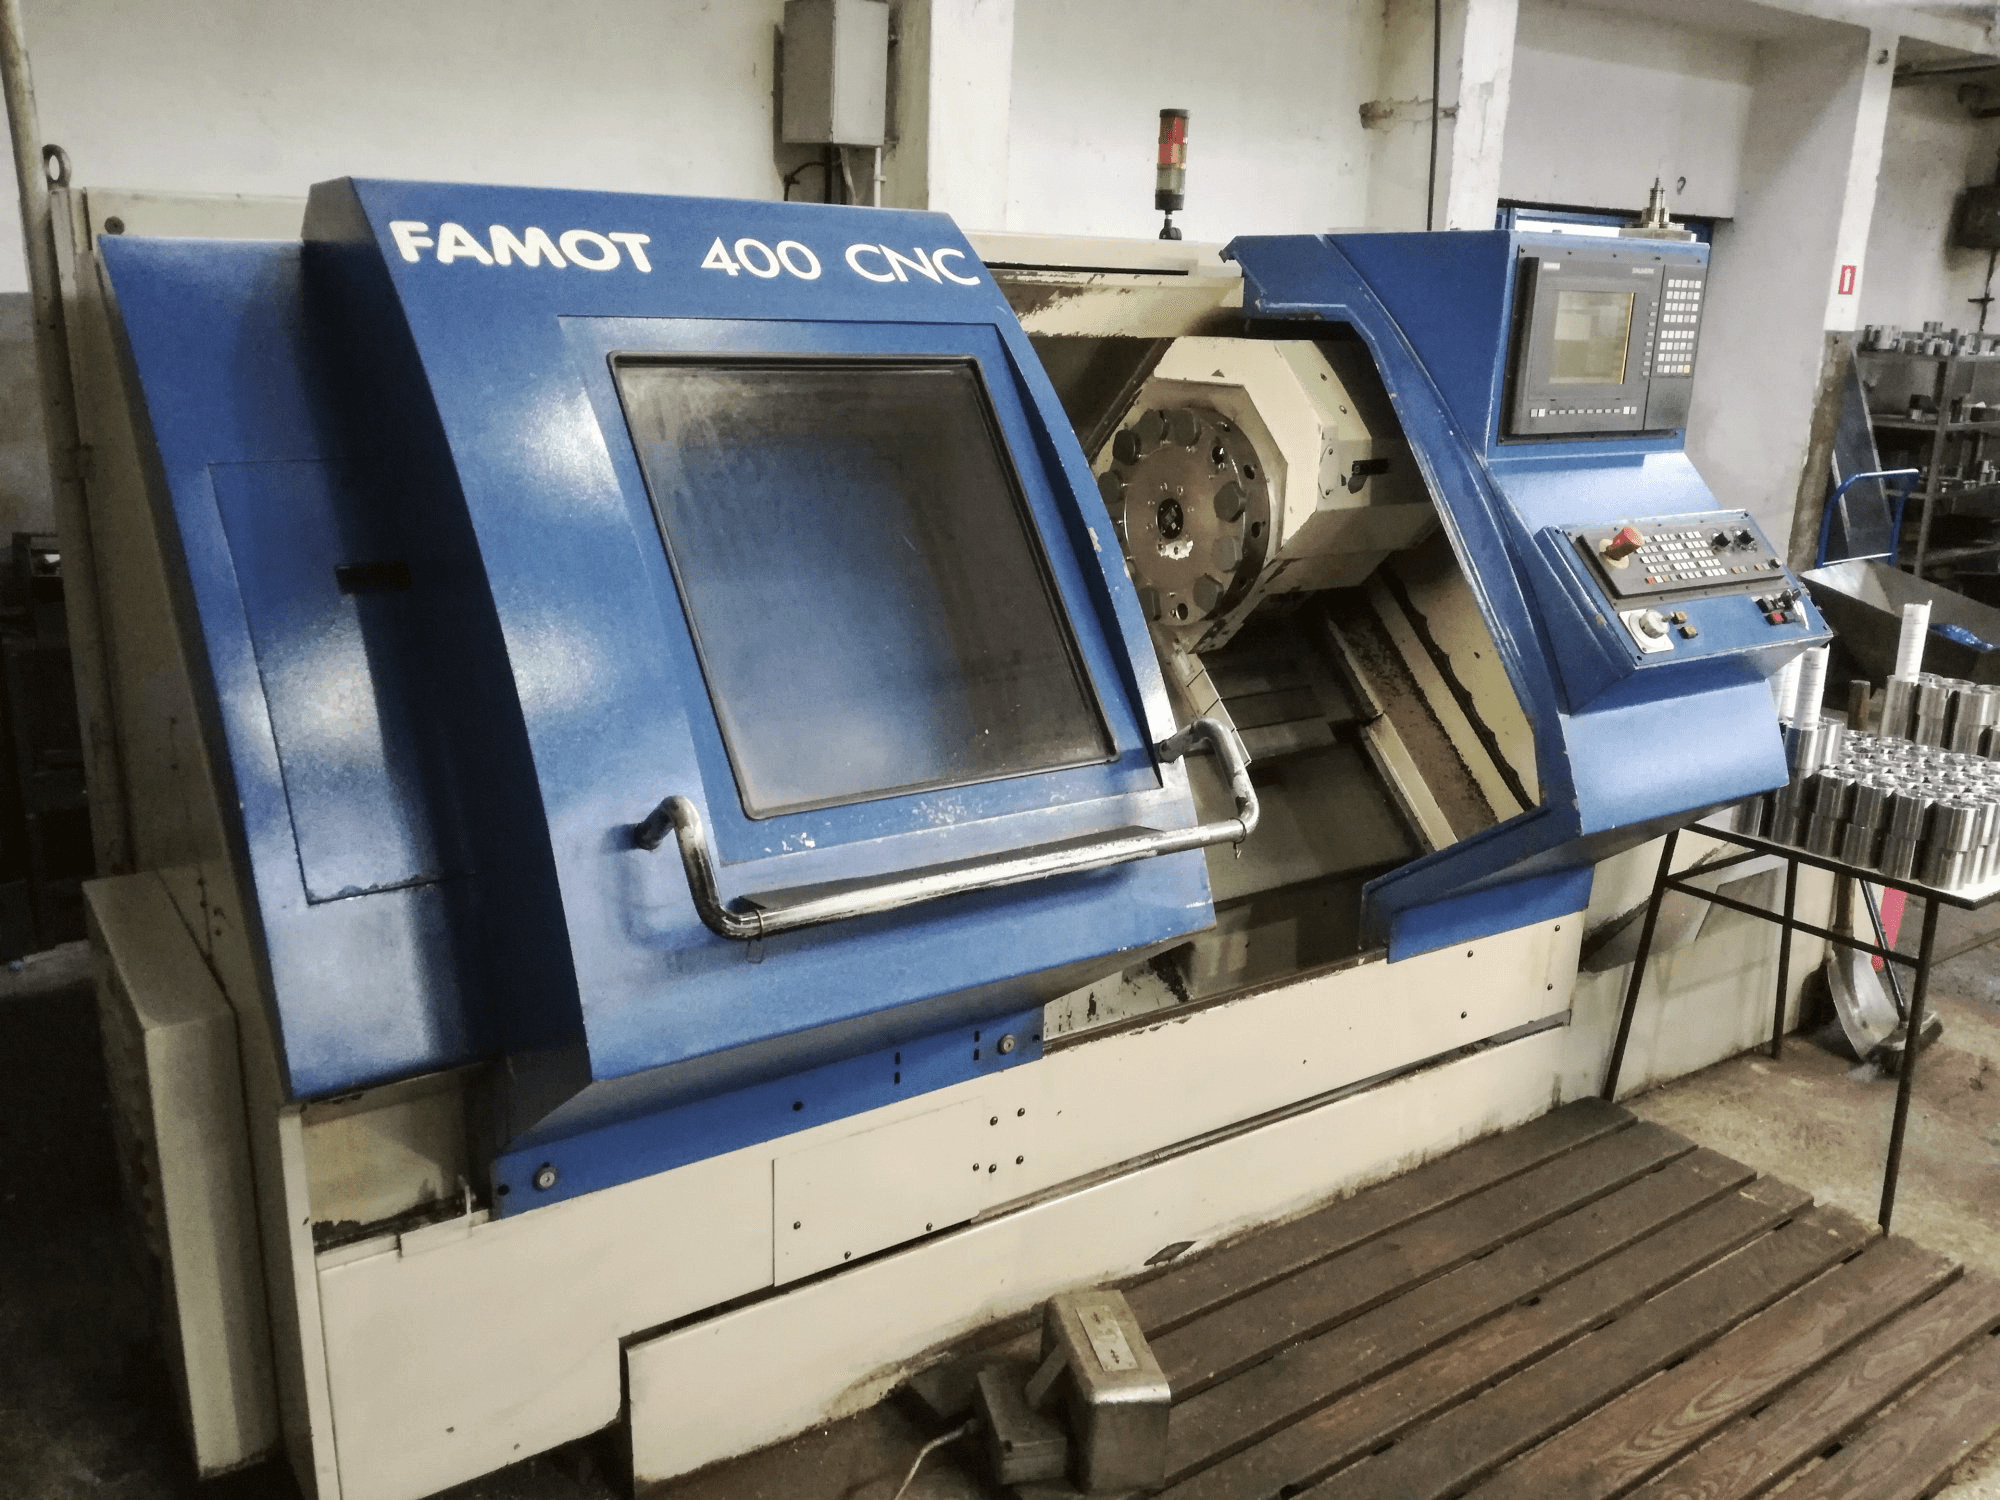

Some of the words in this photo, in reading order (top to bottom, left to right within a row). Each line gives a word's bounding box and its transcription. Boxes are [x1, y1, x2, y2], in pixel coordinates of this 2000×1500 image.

[389, 220, 652, 273] FAMOT
[700, 236, 822, 281] 400
[844, 243, 982, 286] CNC
